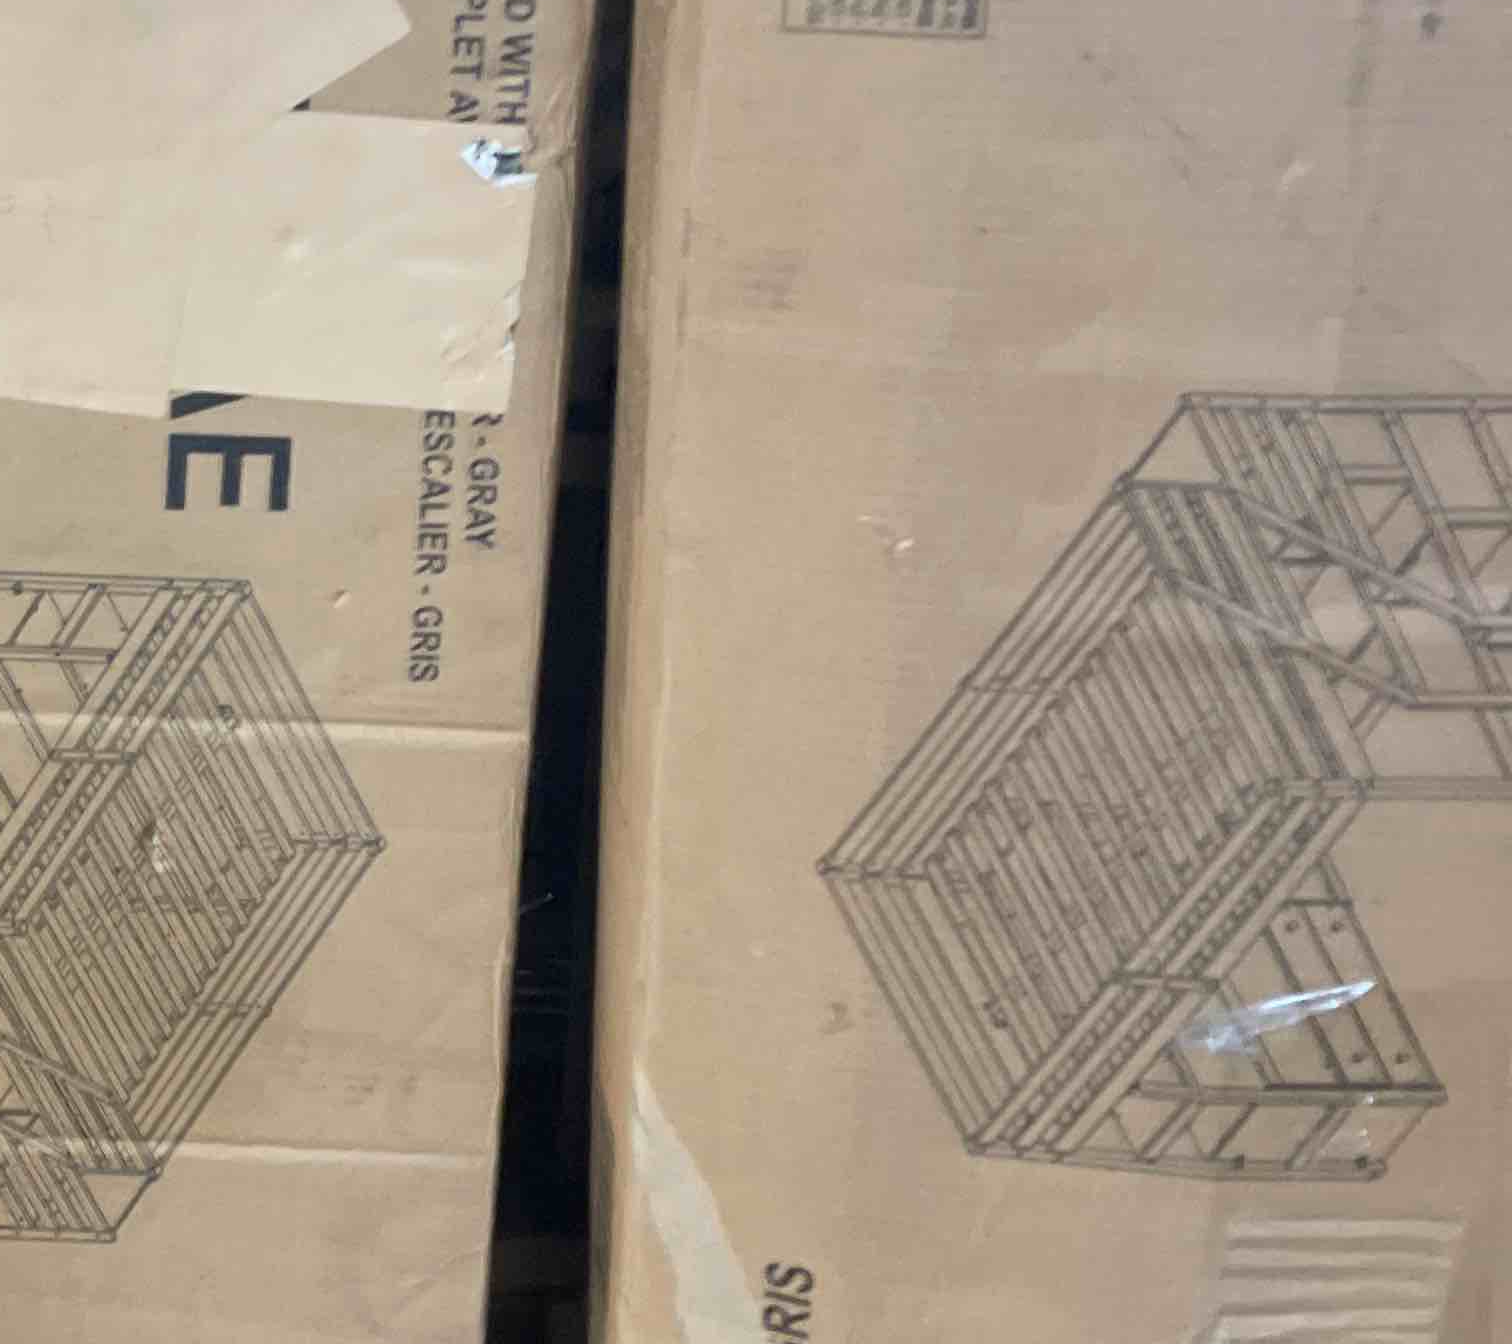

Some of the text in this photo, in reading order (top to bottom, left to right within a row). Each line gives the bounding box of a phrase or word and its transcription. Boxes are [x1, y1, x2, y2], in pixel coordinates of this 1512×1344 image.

[495, 32, 534, 125] WITH
[413, 409, 456, 576] ESCALIER
[464, 457, 501, 550] GRAY
[407, 605, 444, 683] GRIS
